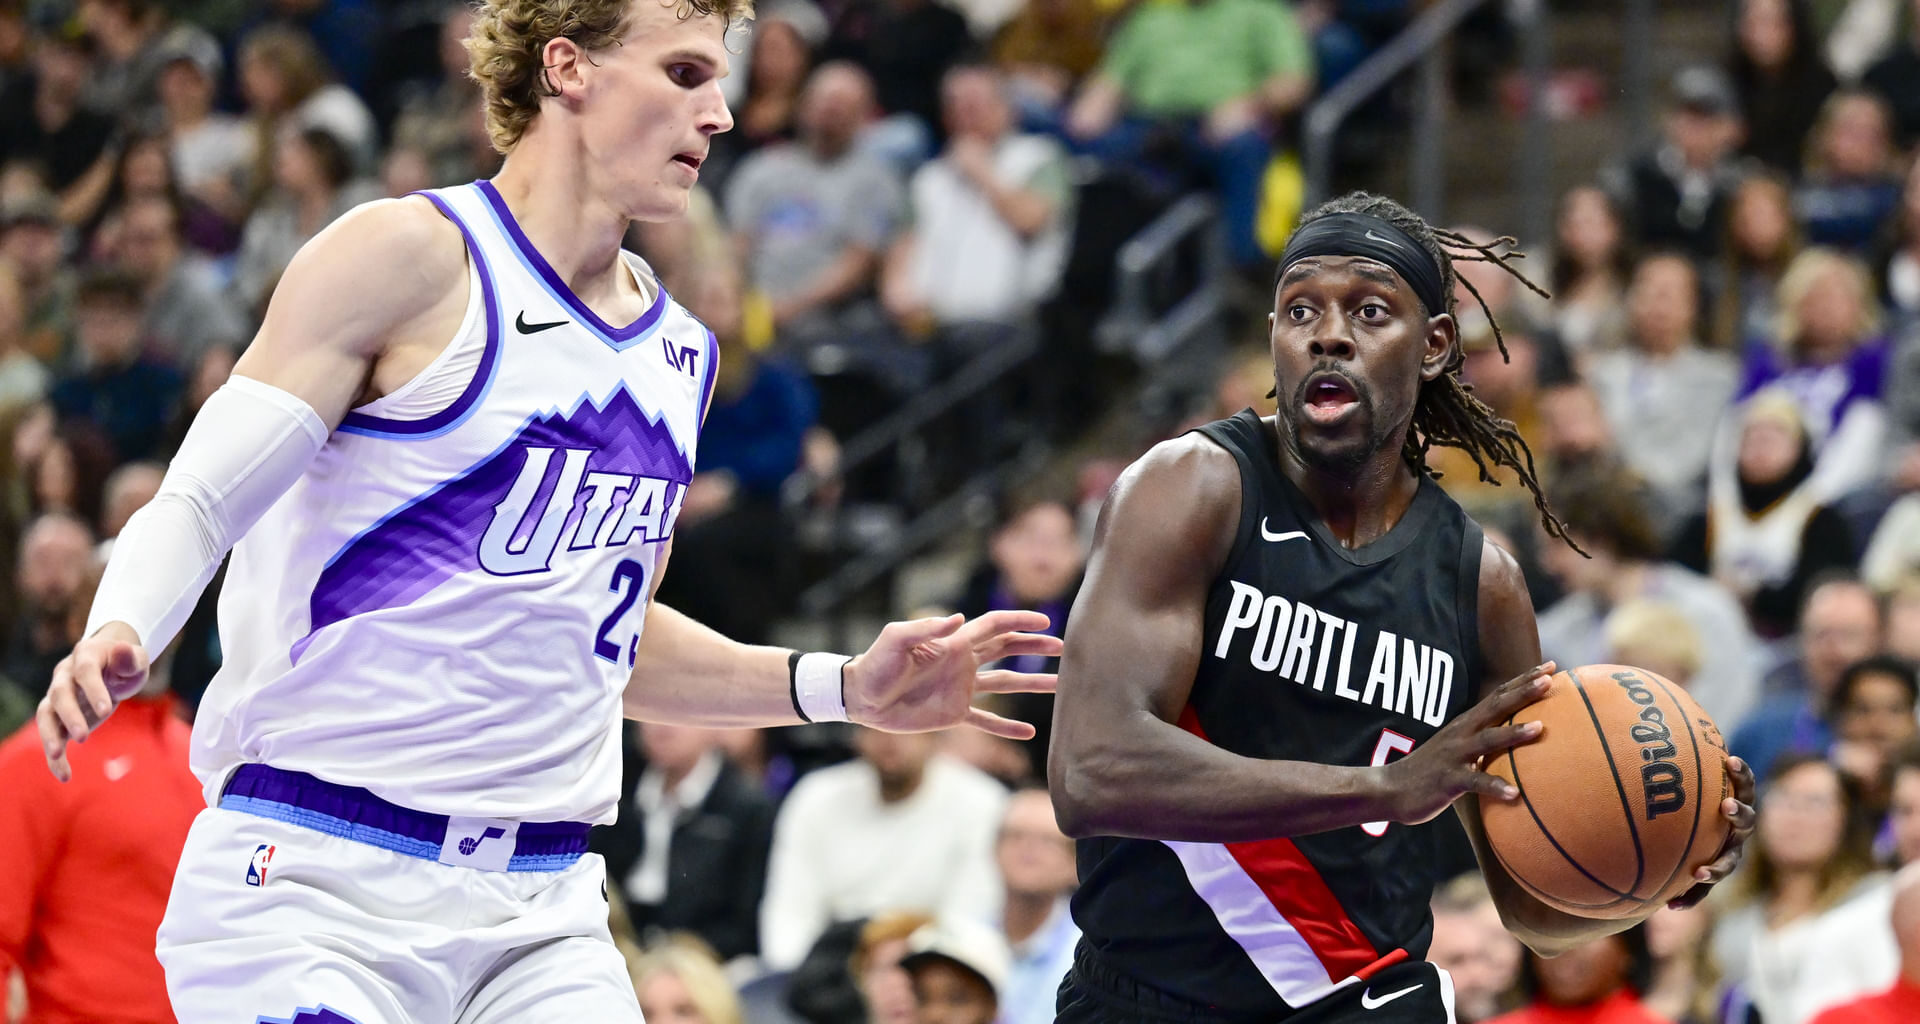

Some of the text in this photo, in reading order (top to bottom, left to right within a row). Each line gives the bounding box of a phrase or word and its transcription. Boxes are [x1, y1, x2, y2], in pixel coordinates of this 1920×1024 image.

[662, 336, 699, 377] LVT
[593, 557, 648, 670] 2
[1214, 579, 1454, 728] PORTLAND
[1610, 671, 1686, 821] Wilson
